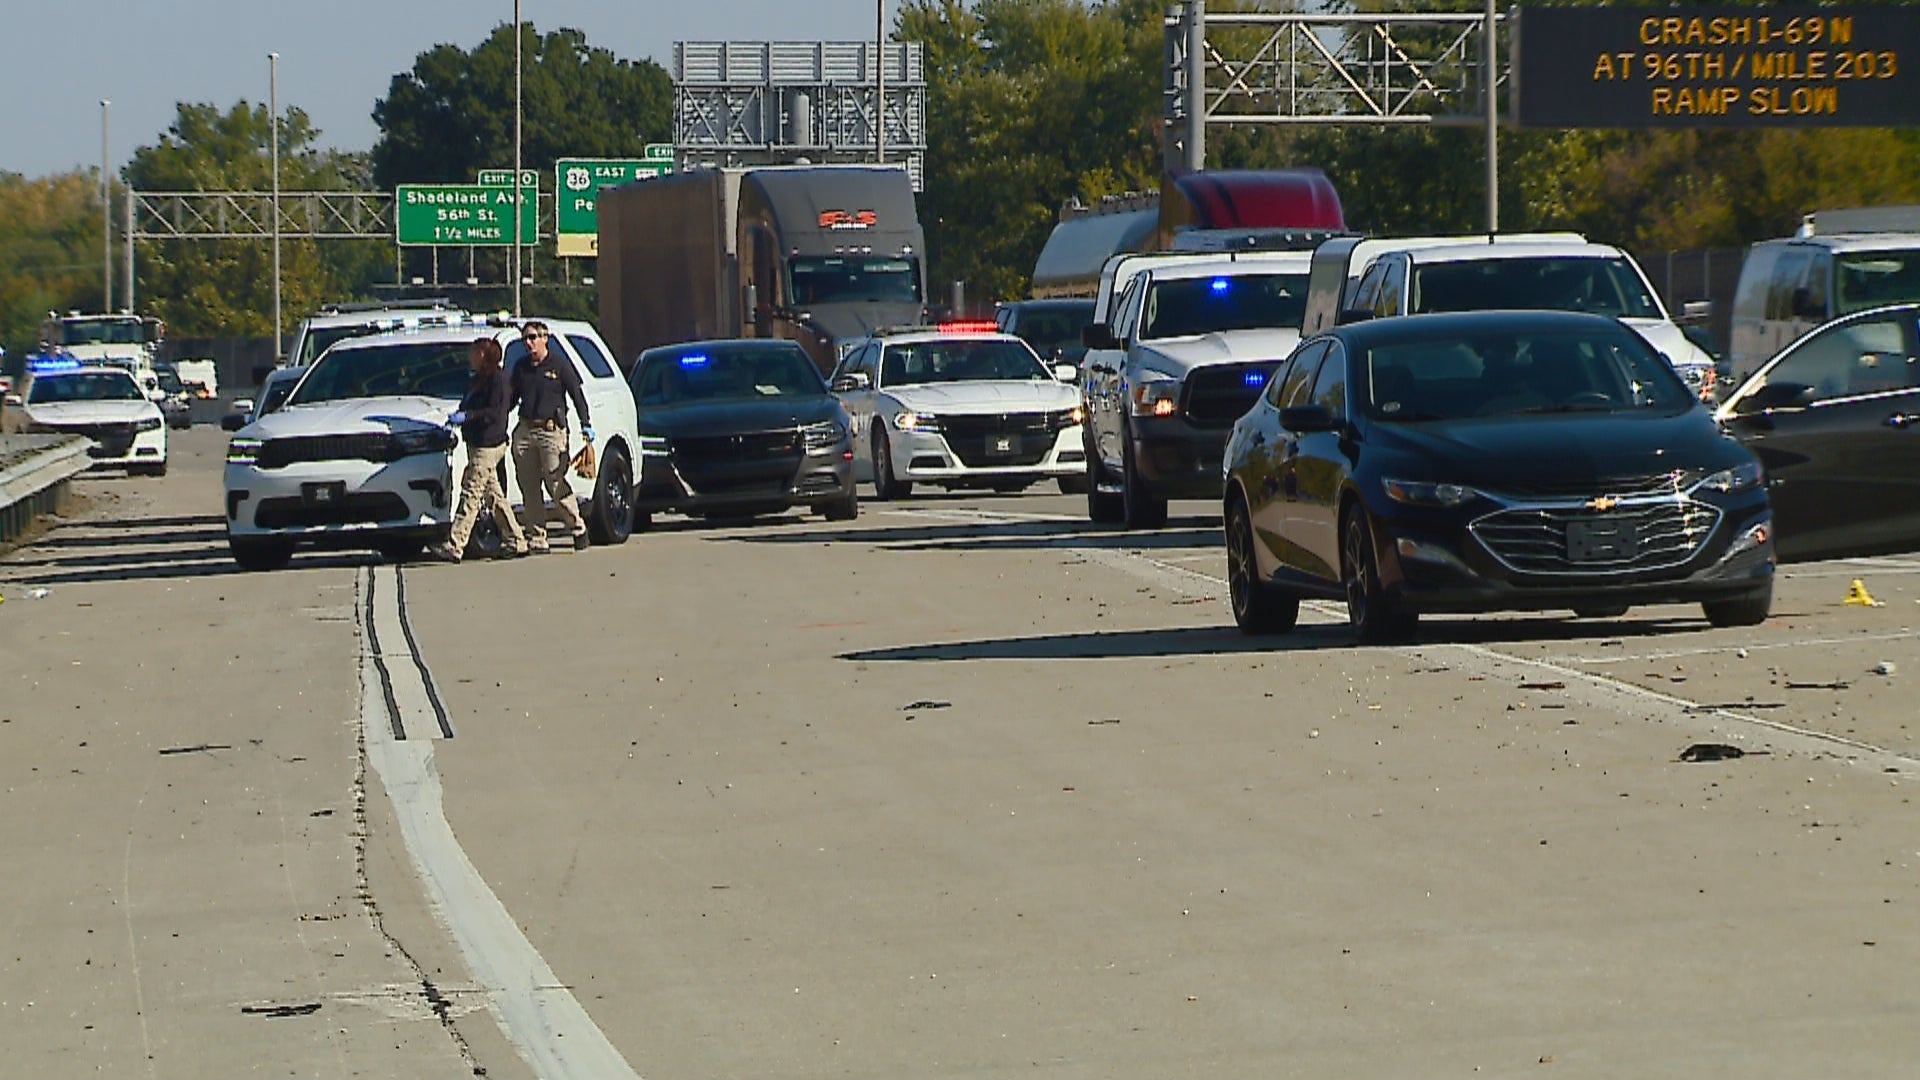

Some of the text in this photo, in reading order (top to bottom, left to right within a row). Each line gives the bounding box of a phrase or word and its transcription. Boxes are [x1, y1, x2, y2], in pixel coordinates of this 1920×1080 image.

[1639, 16, 1853, 45] CRASH I-69 N
[1593, 52, 1636, 80] AT
[1643, 52, 1725, 80] 96TH
[1751, 52, 1828, 80] MILE
[1833, 52, 1898, 80] 203
[1652, 86, 1839, 115] RAMP SLOW
[595, 167, 626, 177] EAST
[484, 174, 506, 184] EXIT
[406, 191, 488, 204] Shadeland
[437, 209, 498, 222] 56th St.
[467, 228, 501, 239] MILES
